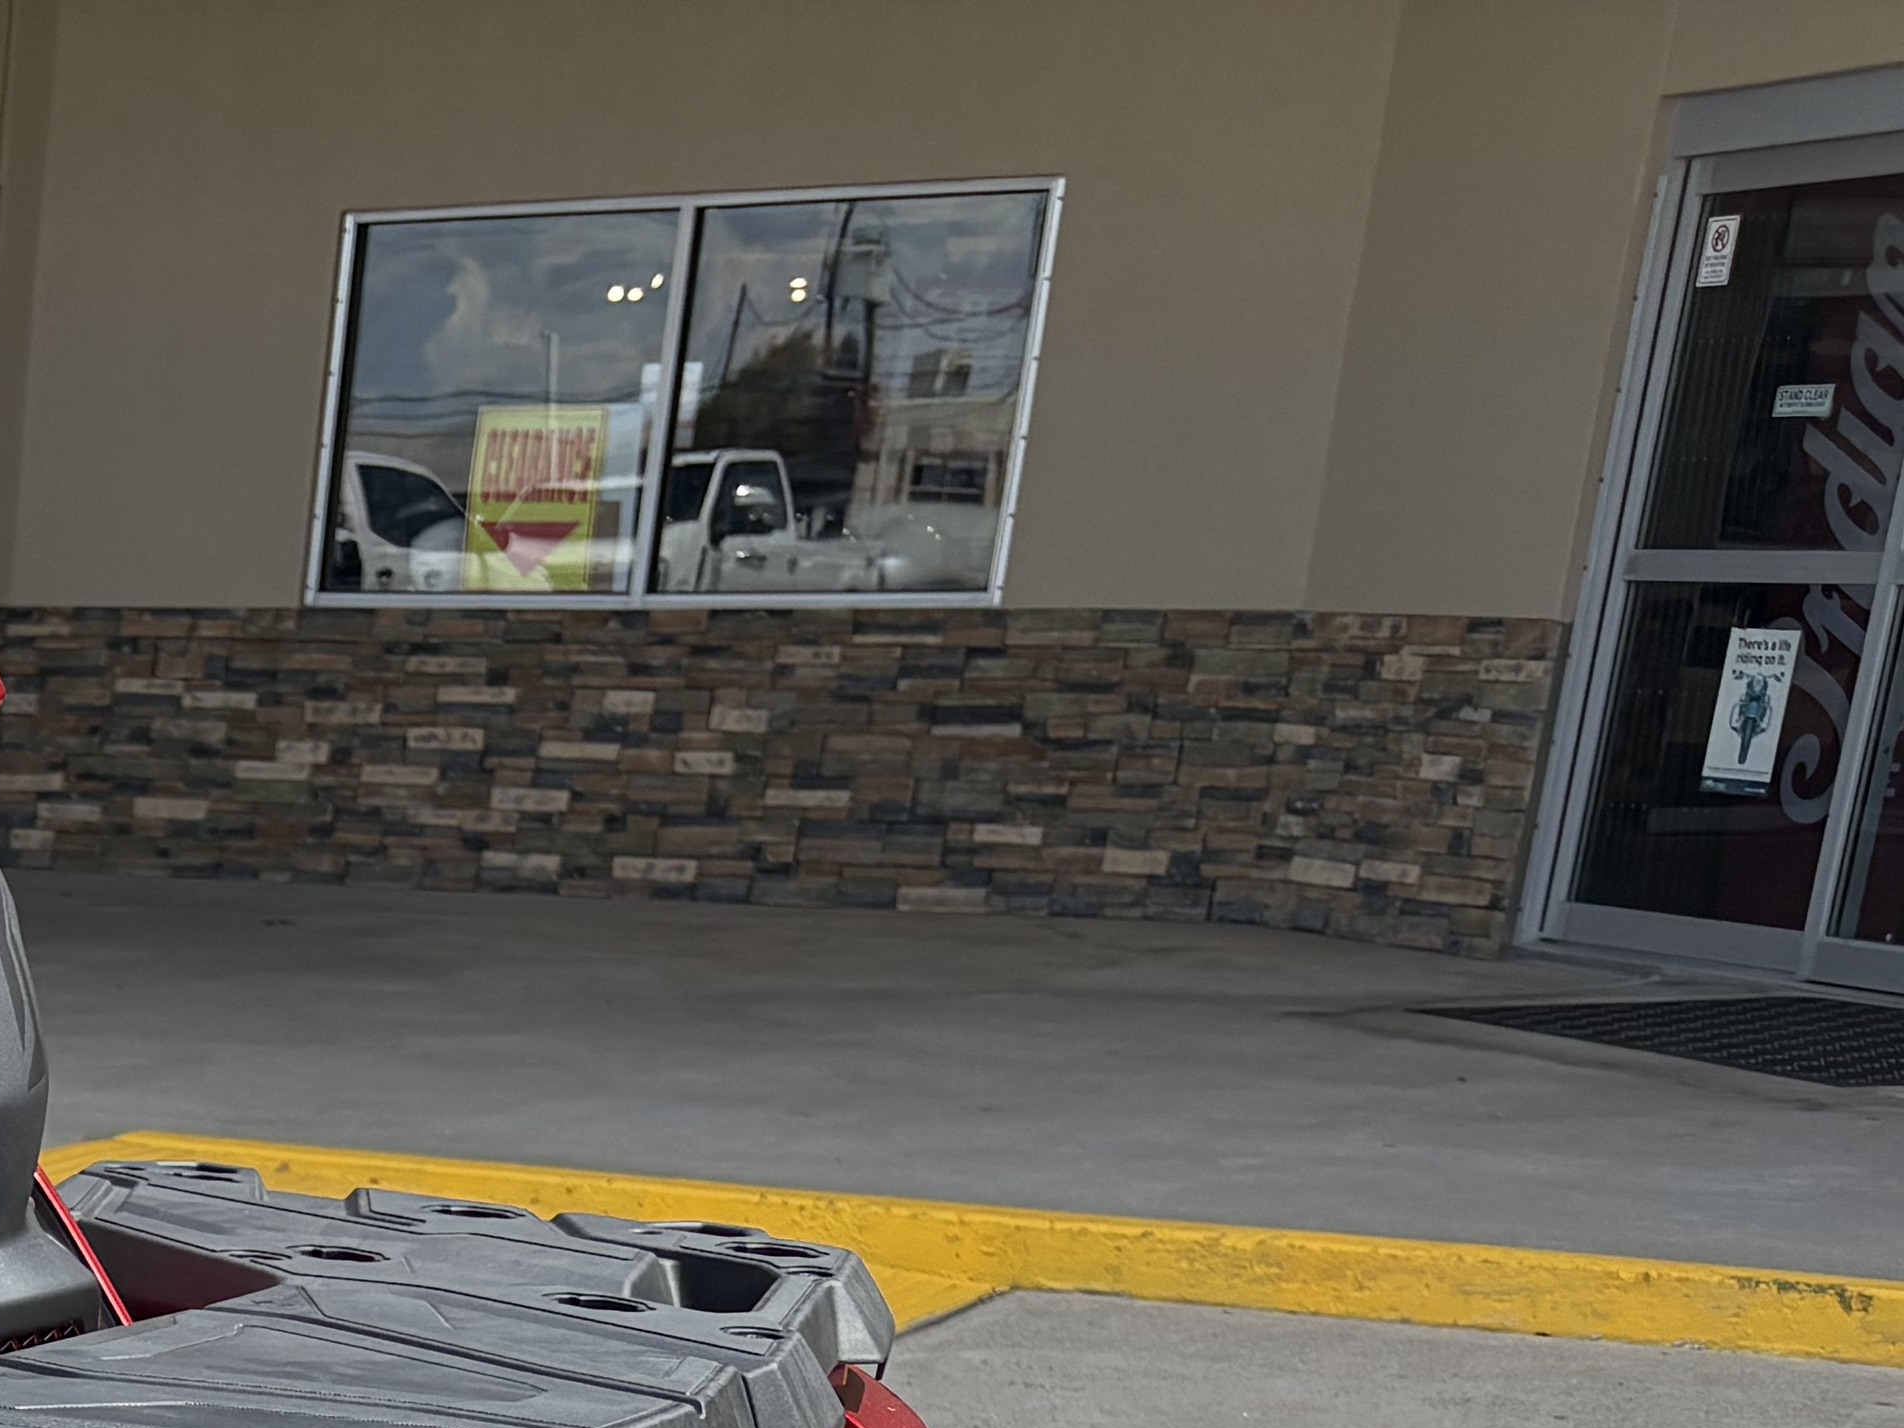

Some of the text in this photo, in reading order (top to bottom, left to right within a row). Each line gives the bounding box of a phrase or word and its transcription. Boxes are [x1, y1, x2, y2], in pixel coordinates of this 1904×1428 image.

[1806, 388, 1829, 400] CLEAR
[1738, 637, 1769, 652] There's
[1735, 654, 1763, 666] riding
